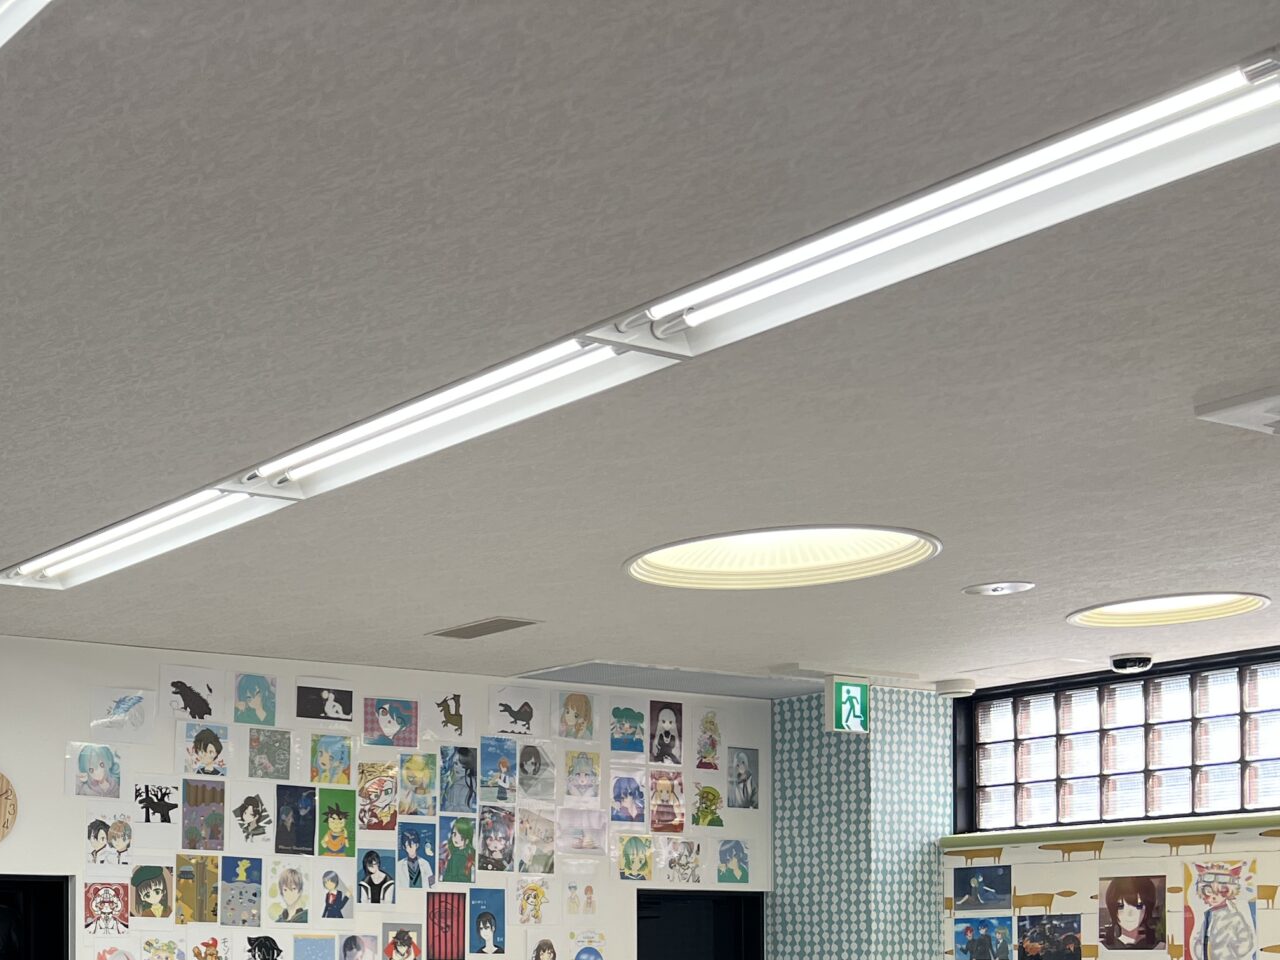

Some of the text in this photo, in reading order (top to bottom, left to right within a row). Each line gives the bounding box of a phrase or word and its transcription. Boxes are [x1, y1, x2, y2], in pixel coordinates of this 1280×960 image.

[4, 789, 13, 801] 2
[8, 803, 16, 816] 3
[2, 818, 9, 830] 4
